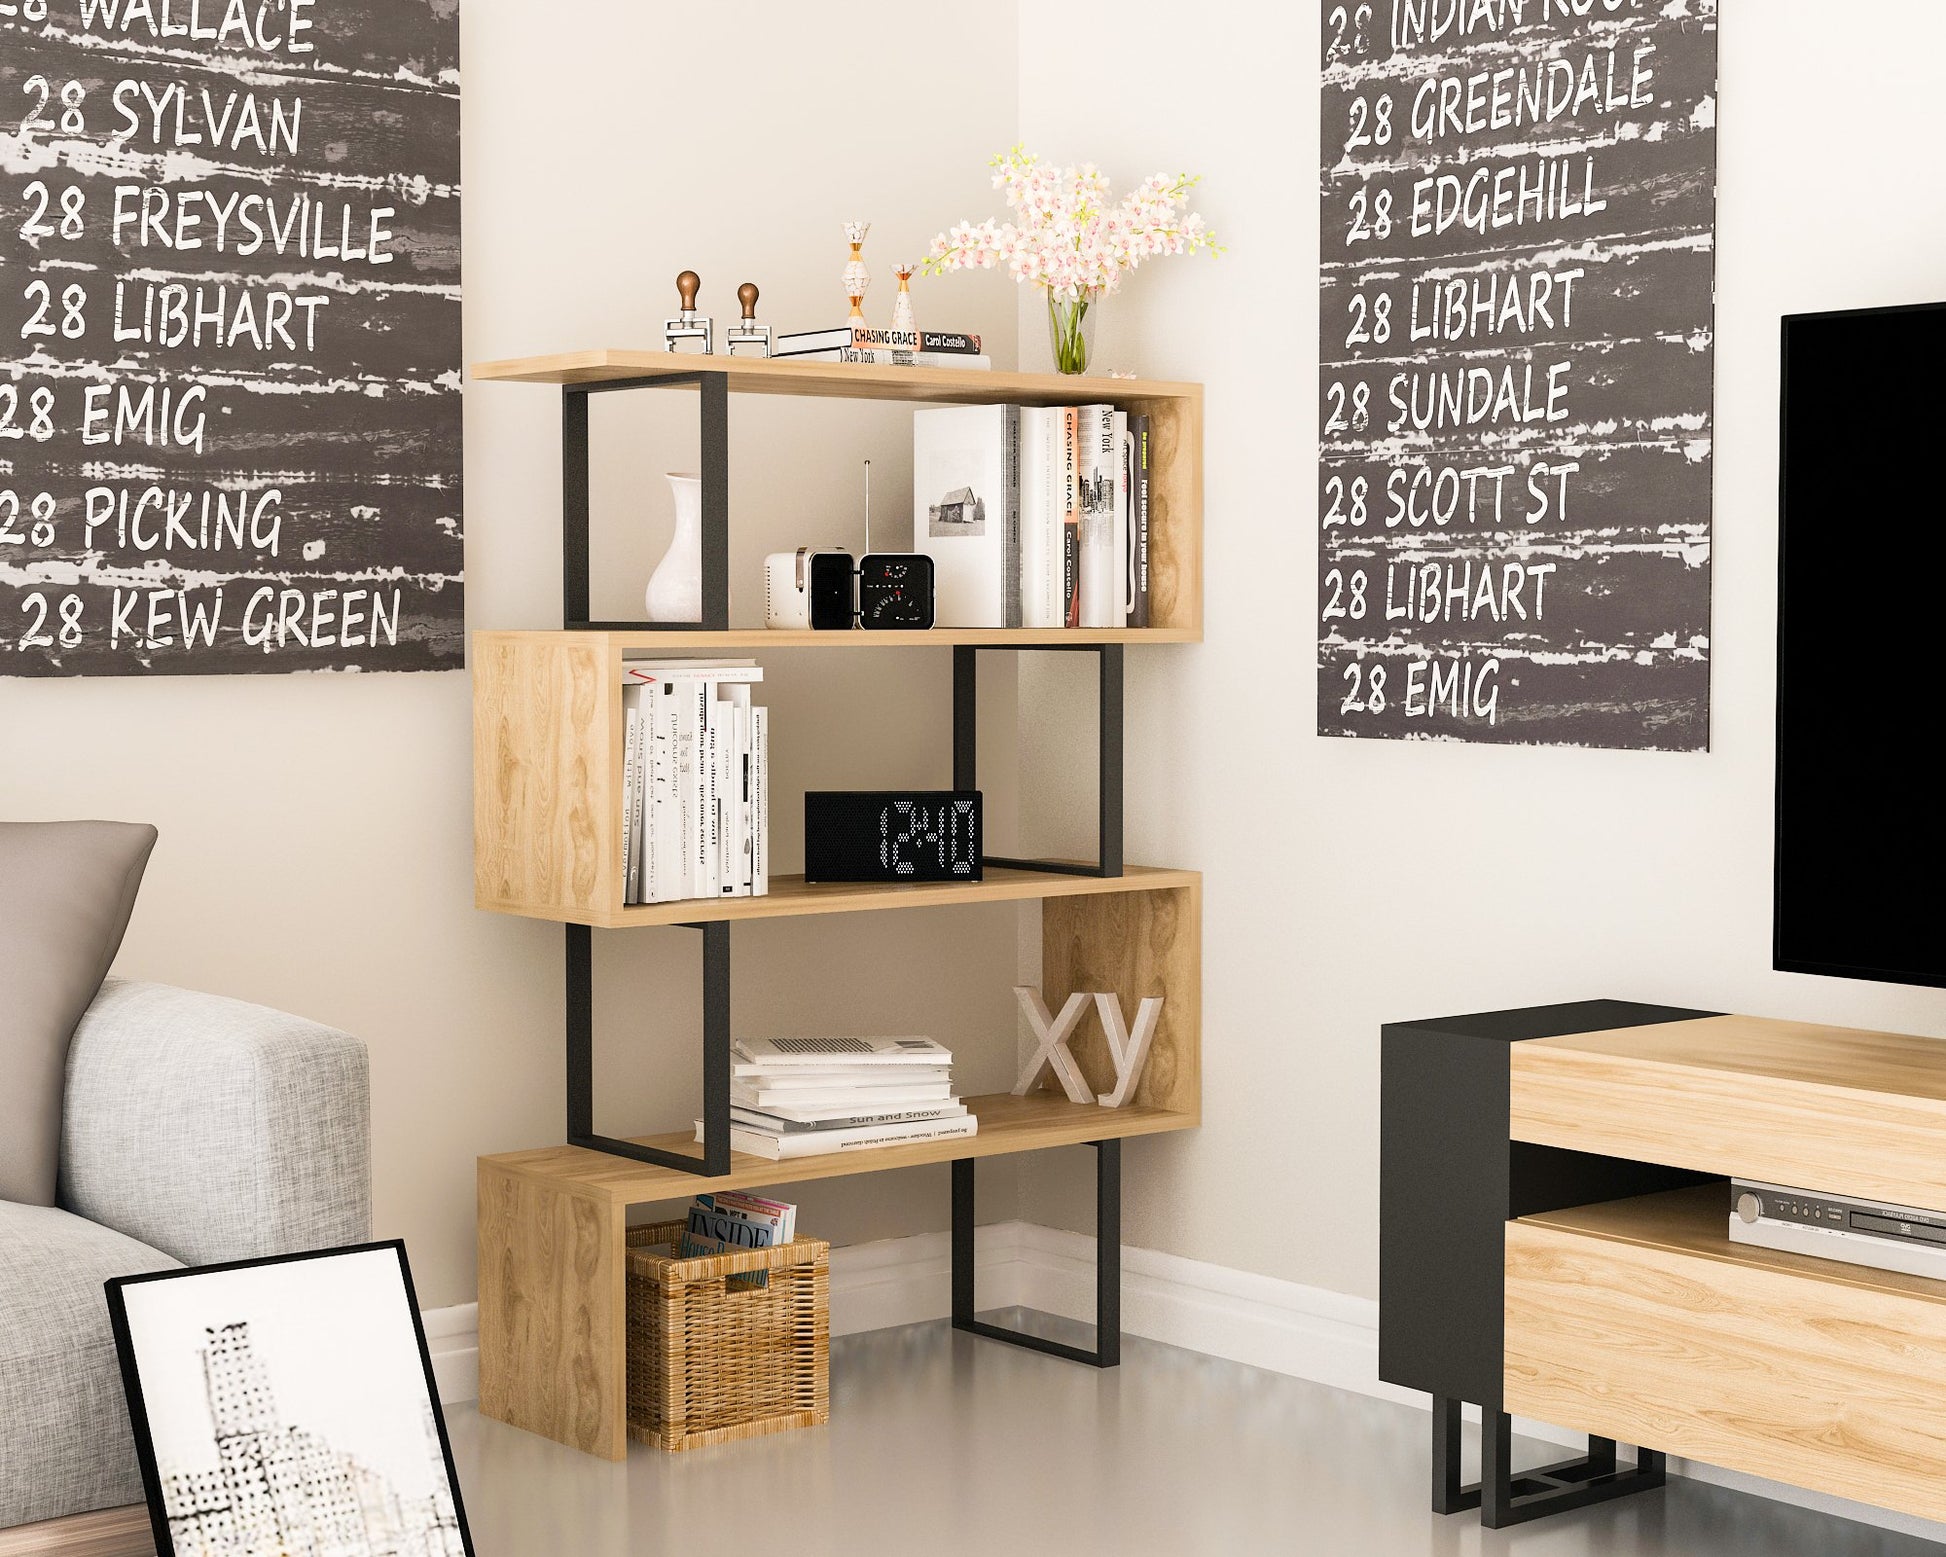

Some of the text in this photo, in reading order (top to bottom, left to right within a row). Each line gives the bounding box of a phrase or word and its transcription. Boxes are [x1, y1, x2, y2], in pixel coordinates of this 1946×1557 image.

[80, 0, 315, 53] WALLACE
[1326, 2, 1372, 61] 28
[19, 74, 302, 156] 28 SYLVAN
[1345, 44, 1657, 152] 28 GREENDALE
[18, 180, 396, 265] 28 FREYSVILLE
[1345, 155, 1606, 246] 28 EDGEHILL
[20, 279, 330, 351] 28 LIBHART
[854, 329, 967, 349] CHASING GRACE Carol Costello
[1345, 268, 1586, 349] 28 LIBHART
[844, 348, 858, 363] New
[859, 348, 875, 364] York
[0, 383, 207, 455] 28 EMIG
[1101, 410, 1113, 454] New York
[1324, 361, 1572, 435] 28 SUNDALE
[0, 485, 282, 557] 28 PICKING
[1322, 462, 1579, 529] 28 SCOTT ST
[18, 585, 401, 655] 28 KEW GREEN
[1321, 562, 1556, 624] 28 LIBHART
[1340, 658, 1500, 726] 28 EMIG
[637, 718, 645, 760] Snow
[849, 1109, 941, 1125] Sun and Snow
[691, 1213, 769, 1249] INSIDE
